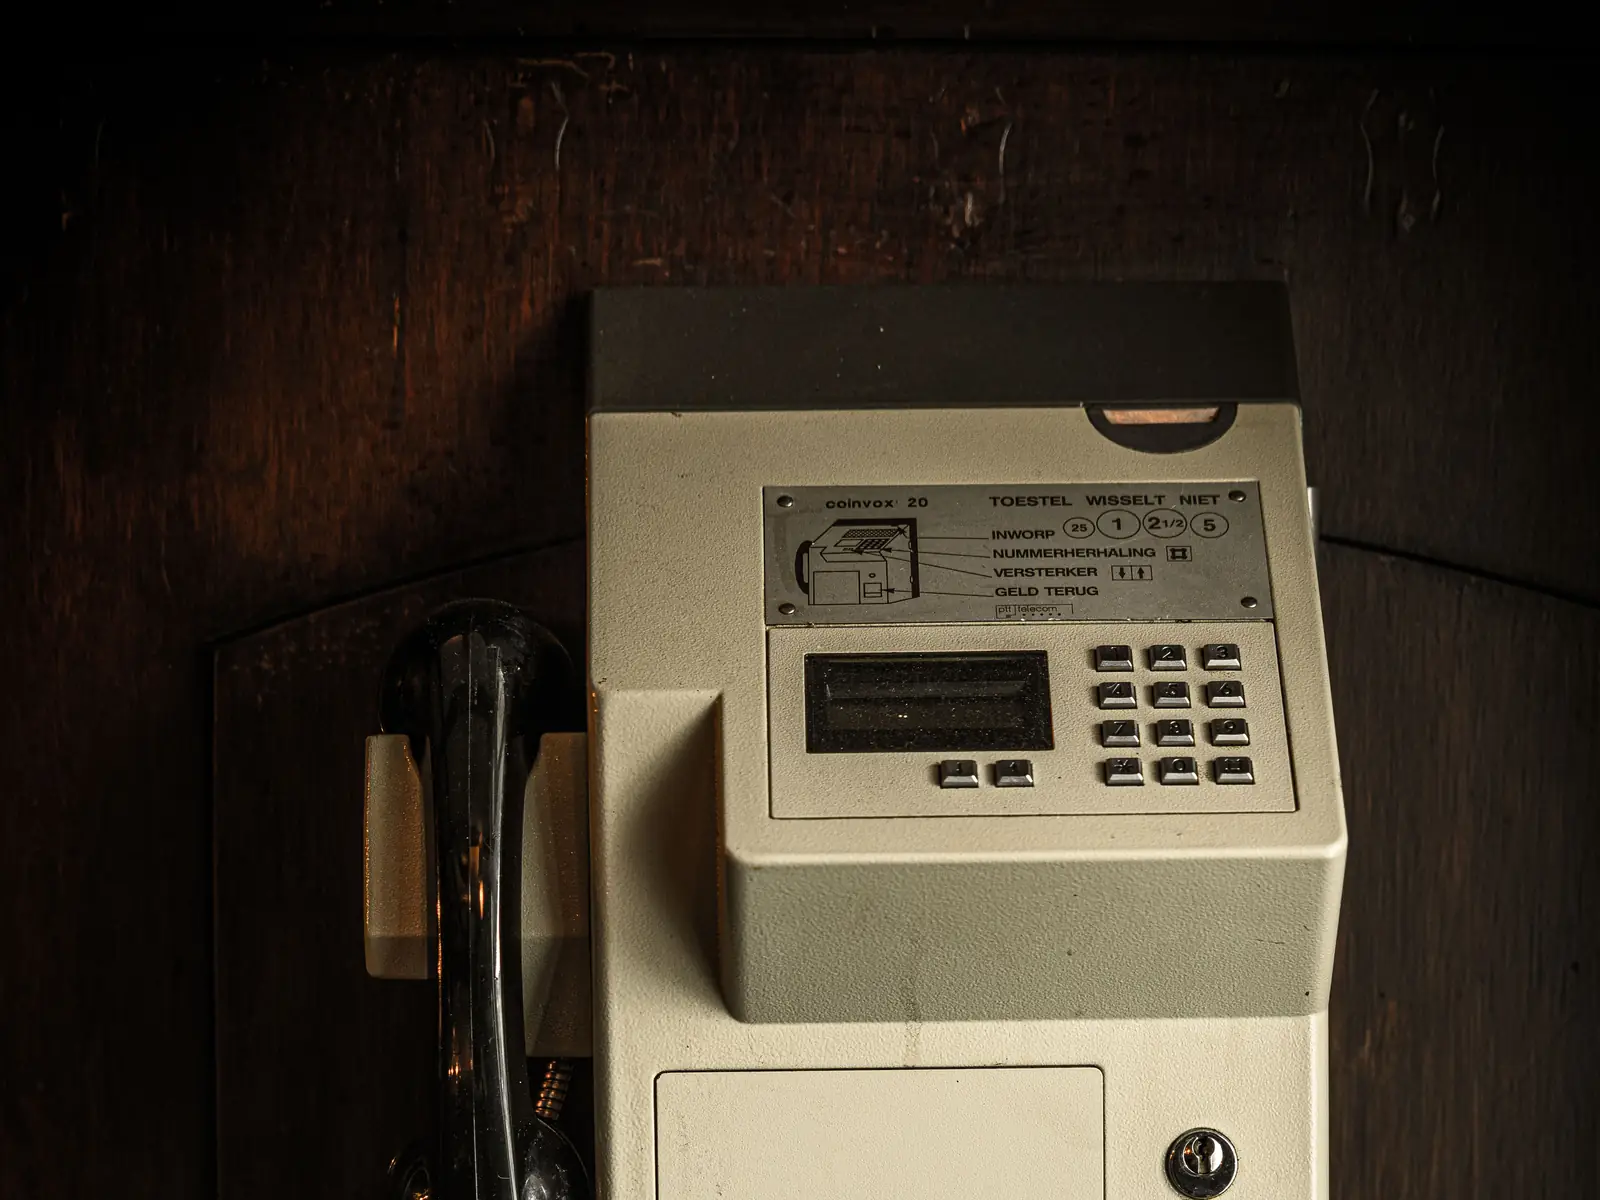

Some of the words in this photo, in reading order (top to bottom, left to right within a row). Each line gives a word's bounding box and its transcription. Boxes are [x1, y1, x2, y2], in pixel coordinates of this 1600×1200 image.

[825, 498, 894, 510] coinvox
[907, 497, 928, 508] 20
[989, 495, 1073, 508] TOESTEL
[1086, 495, 1166, 506] WISSELT
[1180, 494, 1221, 505] NIET
[991, 529, 1056, 540] INWORP
[1071, 523, 1088, 533] 25
[1111, 518, 1122, 531] 1
[1203, 519, 1216, 532] 5
[993, 547, 1156, 559] NUMMERHERHALING
[993, 567, 1098, 578] VERSTERKER
[995, 586, 1039, 597] GELD
[1044, 586, 1099, 597] TERUG
[1018, 604, 1058, 613] telecom
[1161, 646, 1174, 659] 2
[1215, 645, 1228, 659] 3
[1113, 721, 1126, 735] 7
